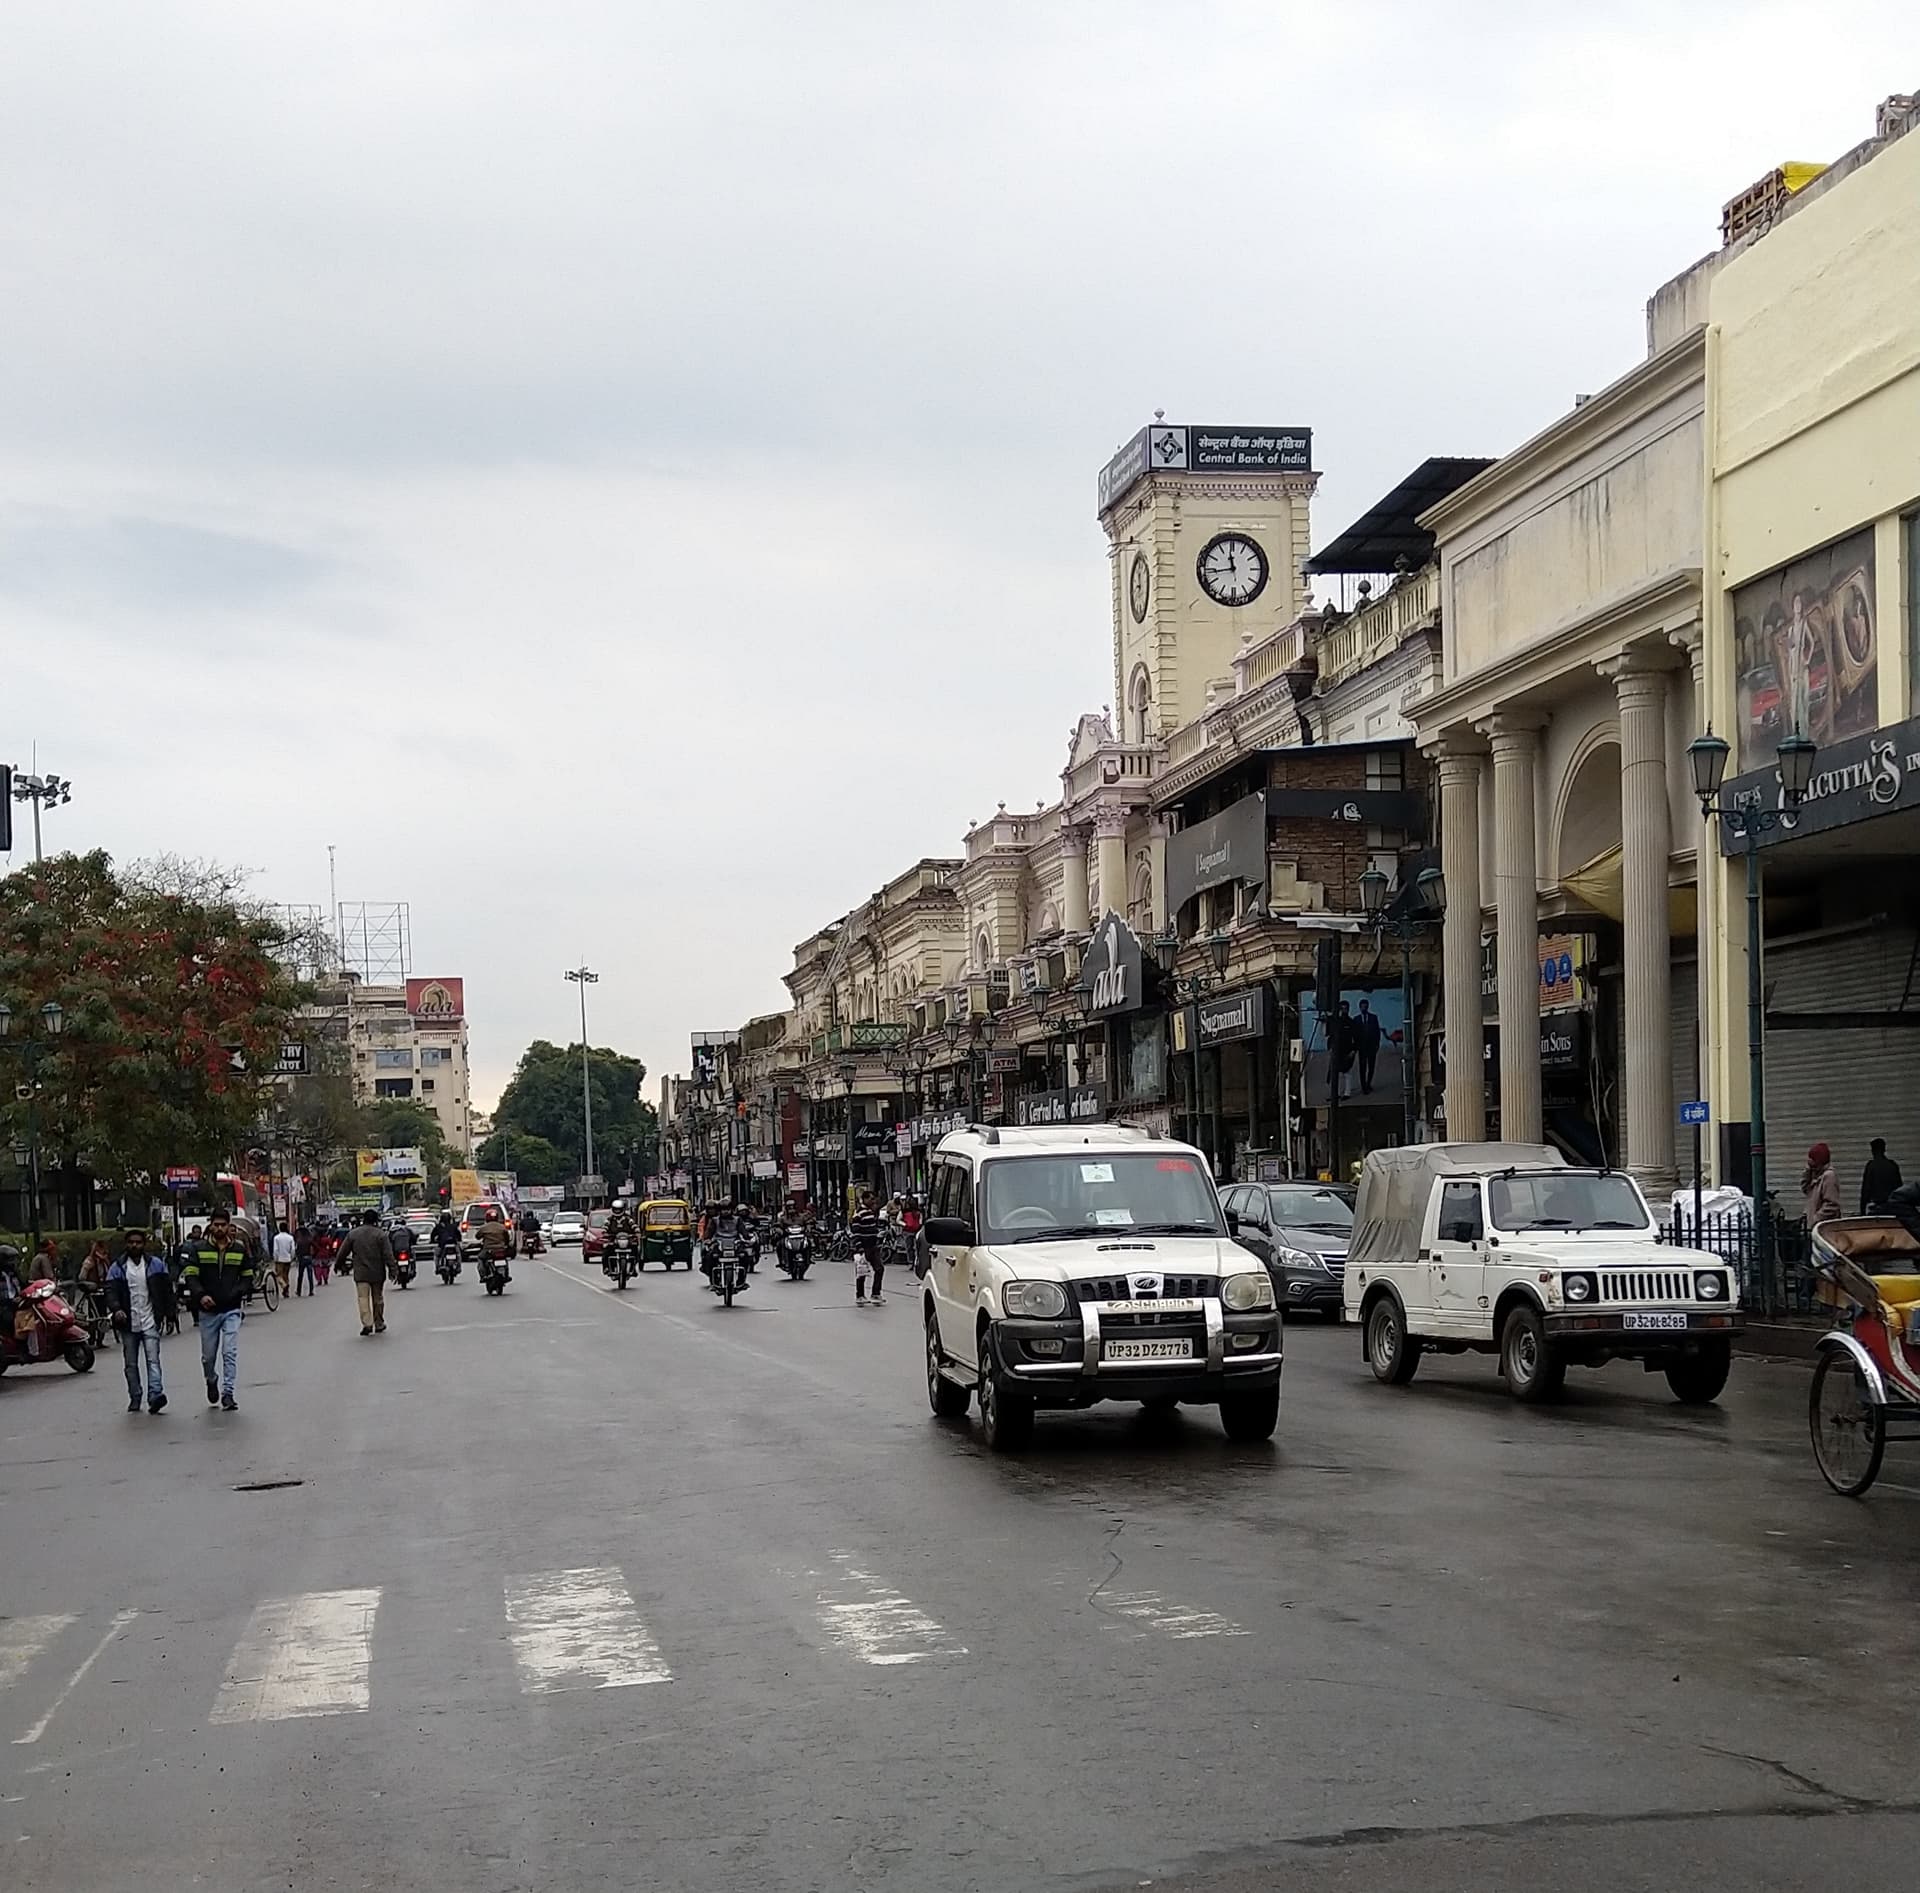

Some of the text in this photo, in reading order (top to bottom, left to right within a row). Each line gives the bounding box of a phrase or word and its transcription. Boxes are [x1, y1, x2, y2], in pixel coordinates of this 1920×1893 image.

[1198, 451, 1307, 464] Central Bank of India
[1775, 739, 1901, 830] CLCUTTA'S
[1200, 1000, 1246, 1038] Sugnamal
[280, 1045, 302, 1058] TRY
[1550, 1031, 1571, 1052] Sons
[992, 1059, 1017, 1068] ATM
[1029, 1097, 1052, 1124] Central
[1053, 1097, 1066, 1121] Ban
